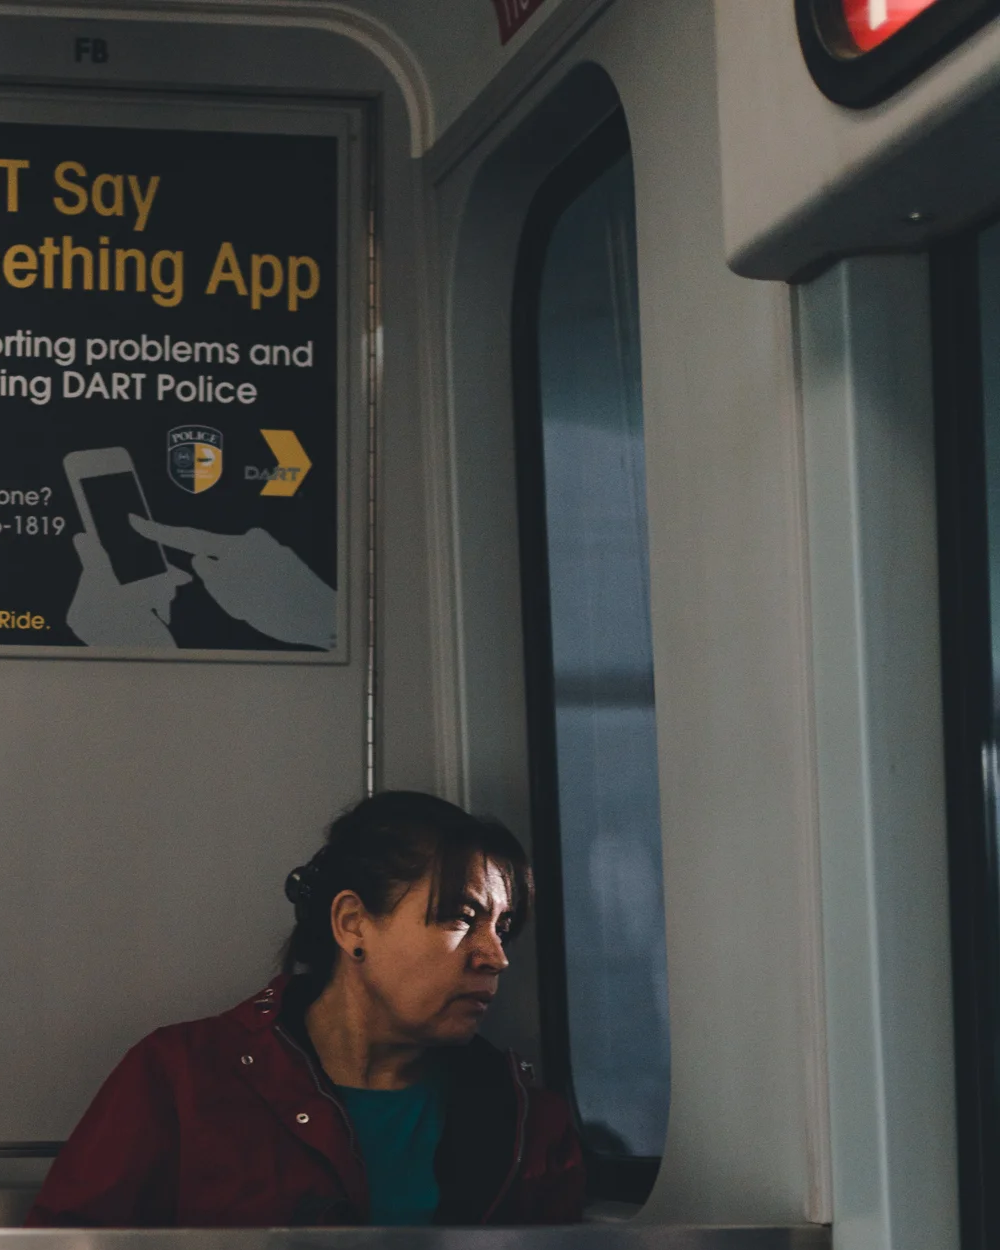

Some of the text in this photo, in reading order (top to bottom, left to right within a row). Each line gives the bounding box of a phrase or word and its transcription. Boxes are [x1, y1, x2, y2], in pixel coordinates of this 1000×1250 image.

[53, 160, 161, 232] Say
[204, 241, 321, 312] App
[85, 333, 241, 375] problems
[249, 340, 314, 368] and
[62, 370, 147, 401] DART
[157, 373, 258, 404] Police
[171, 430, 217, 444] POLICE
[244, 465, 301, 481] DART
